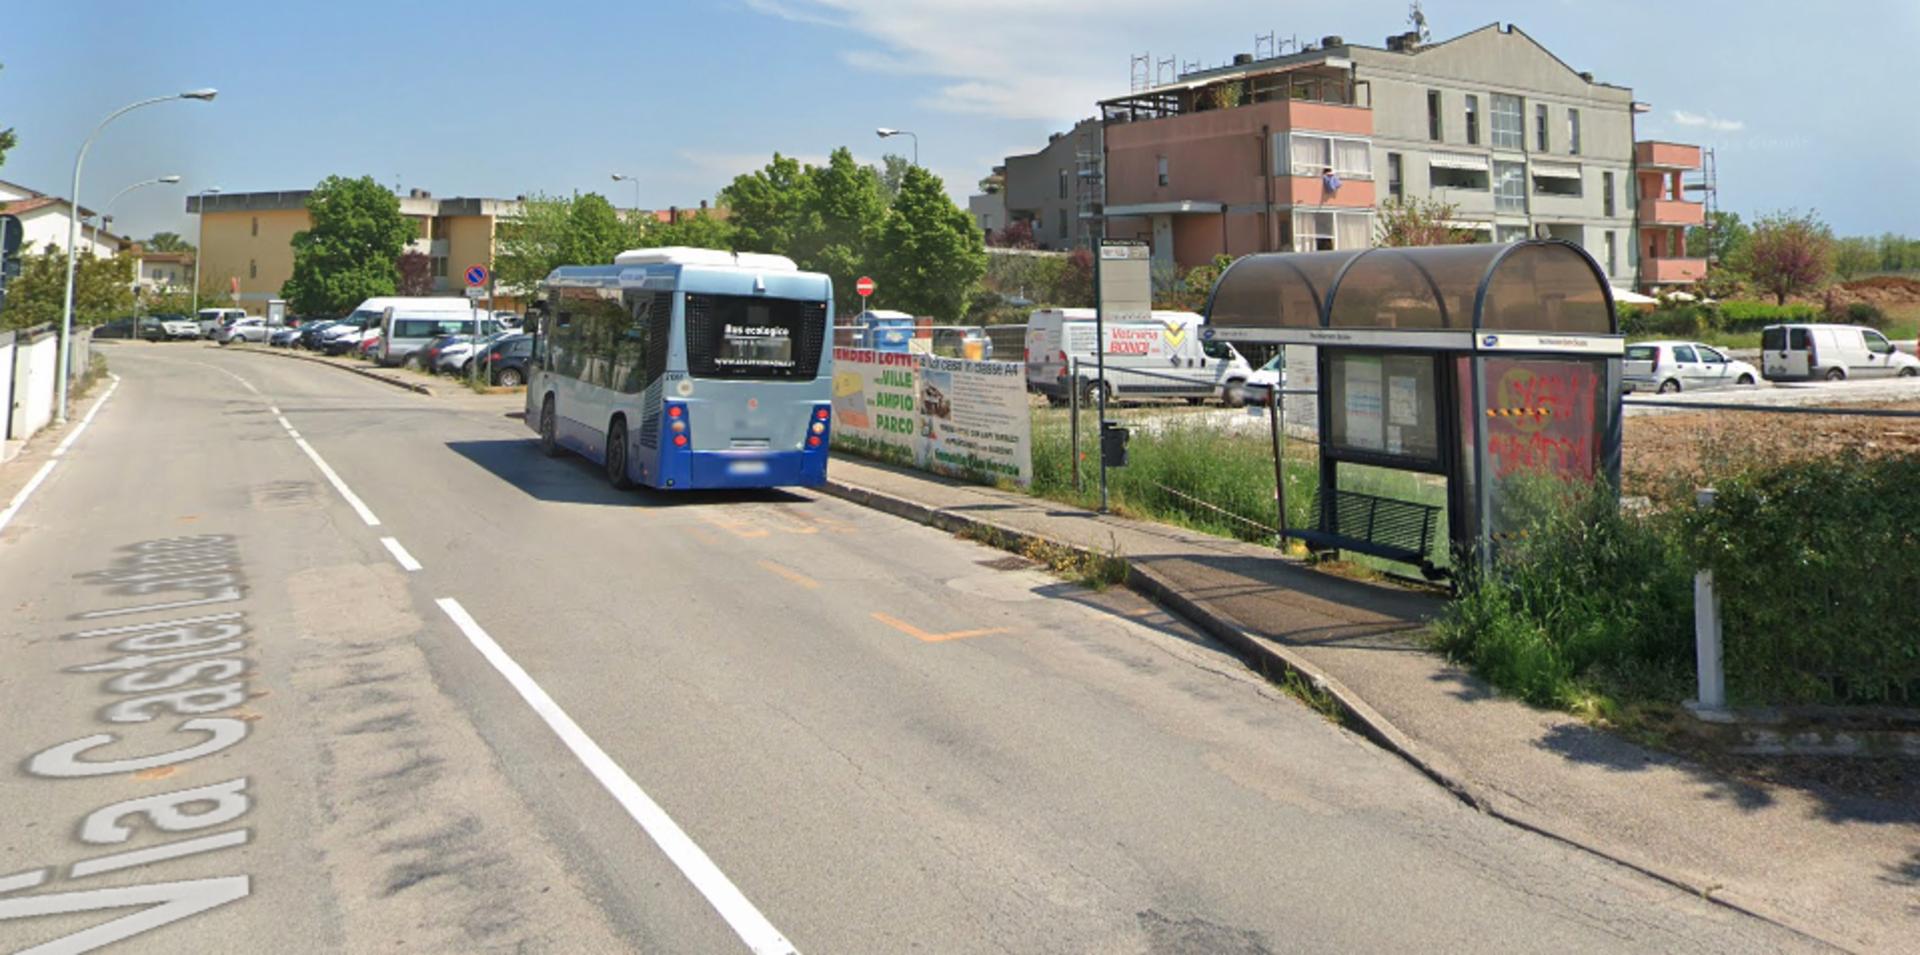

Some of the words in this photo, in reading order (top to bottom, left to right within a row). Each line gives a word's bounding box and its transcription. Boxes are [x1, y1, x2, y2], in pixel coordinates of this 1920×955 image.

[725, 324, 743, 334] Bus
[745, 326, 789, 337] ecologico
[878, 352, 913, 368] LOTTI
[882, 369, 913, 389] VILLE
[876, 392, 914, 412] AMPIO
[876, 414, 914, 435] PARCO
